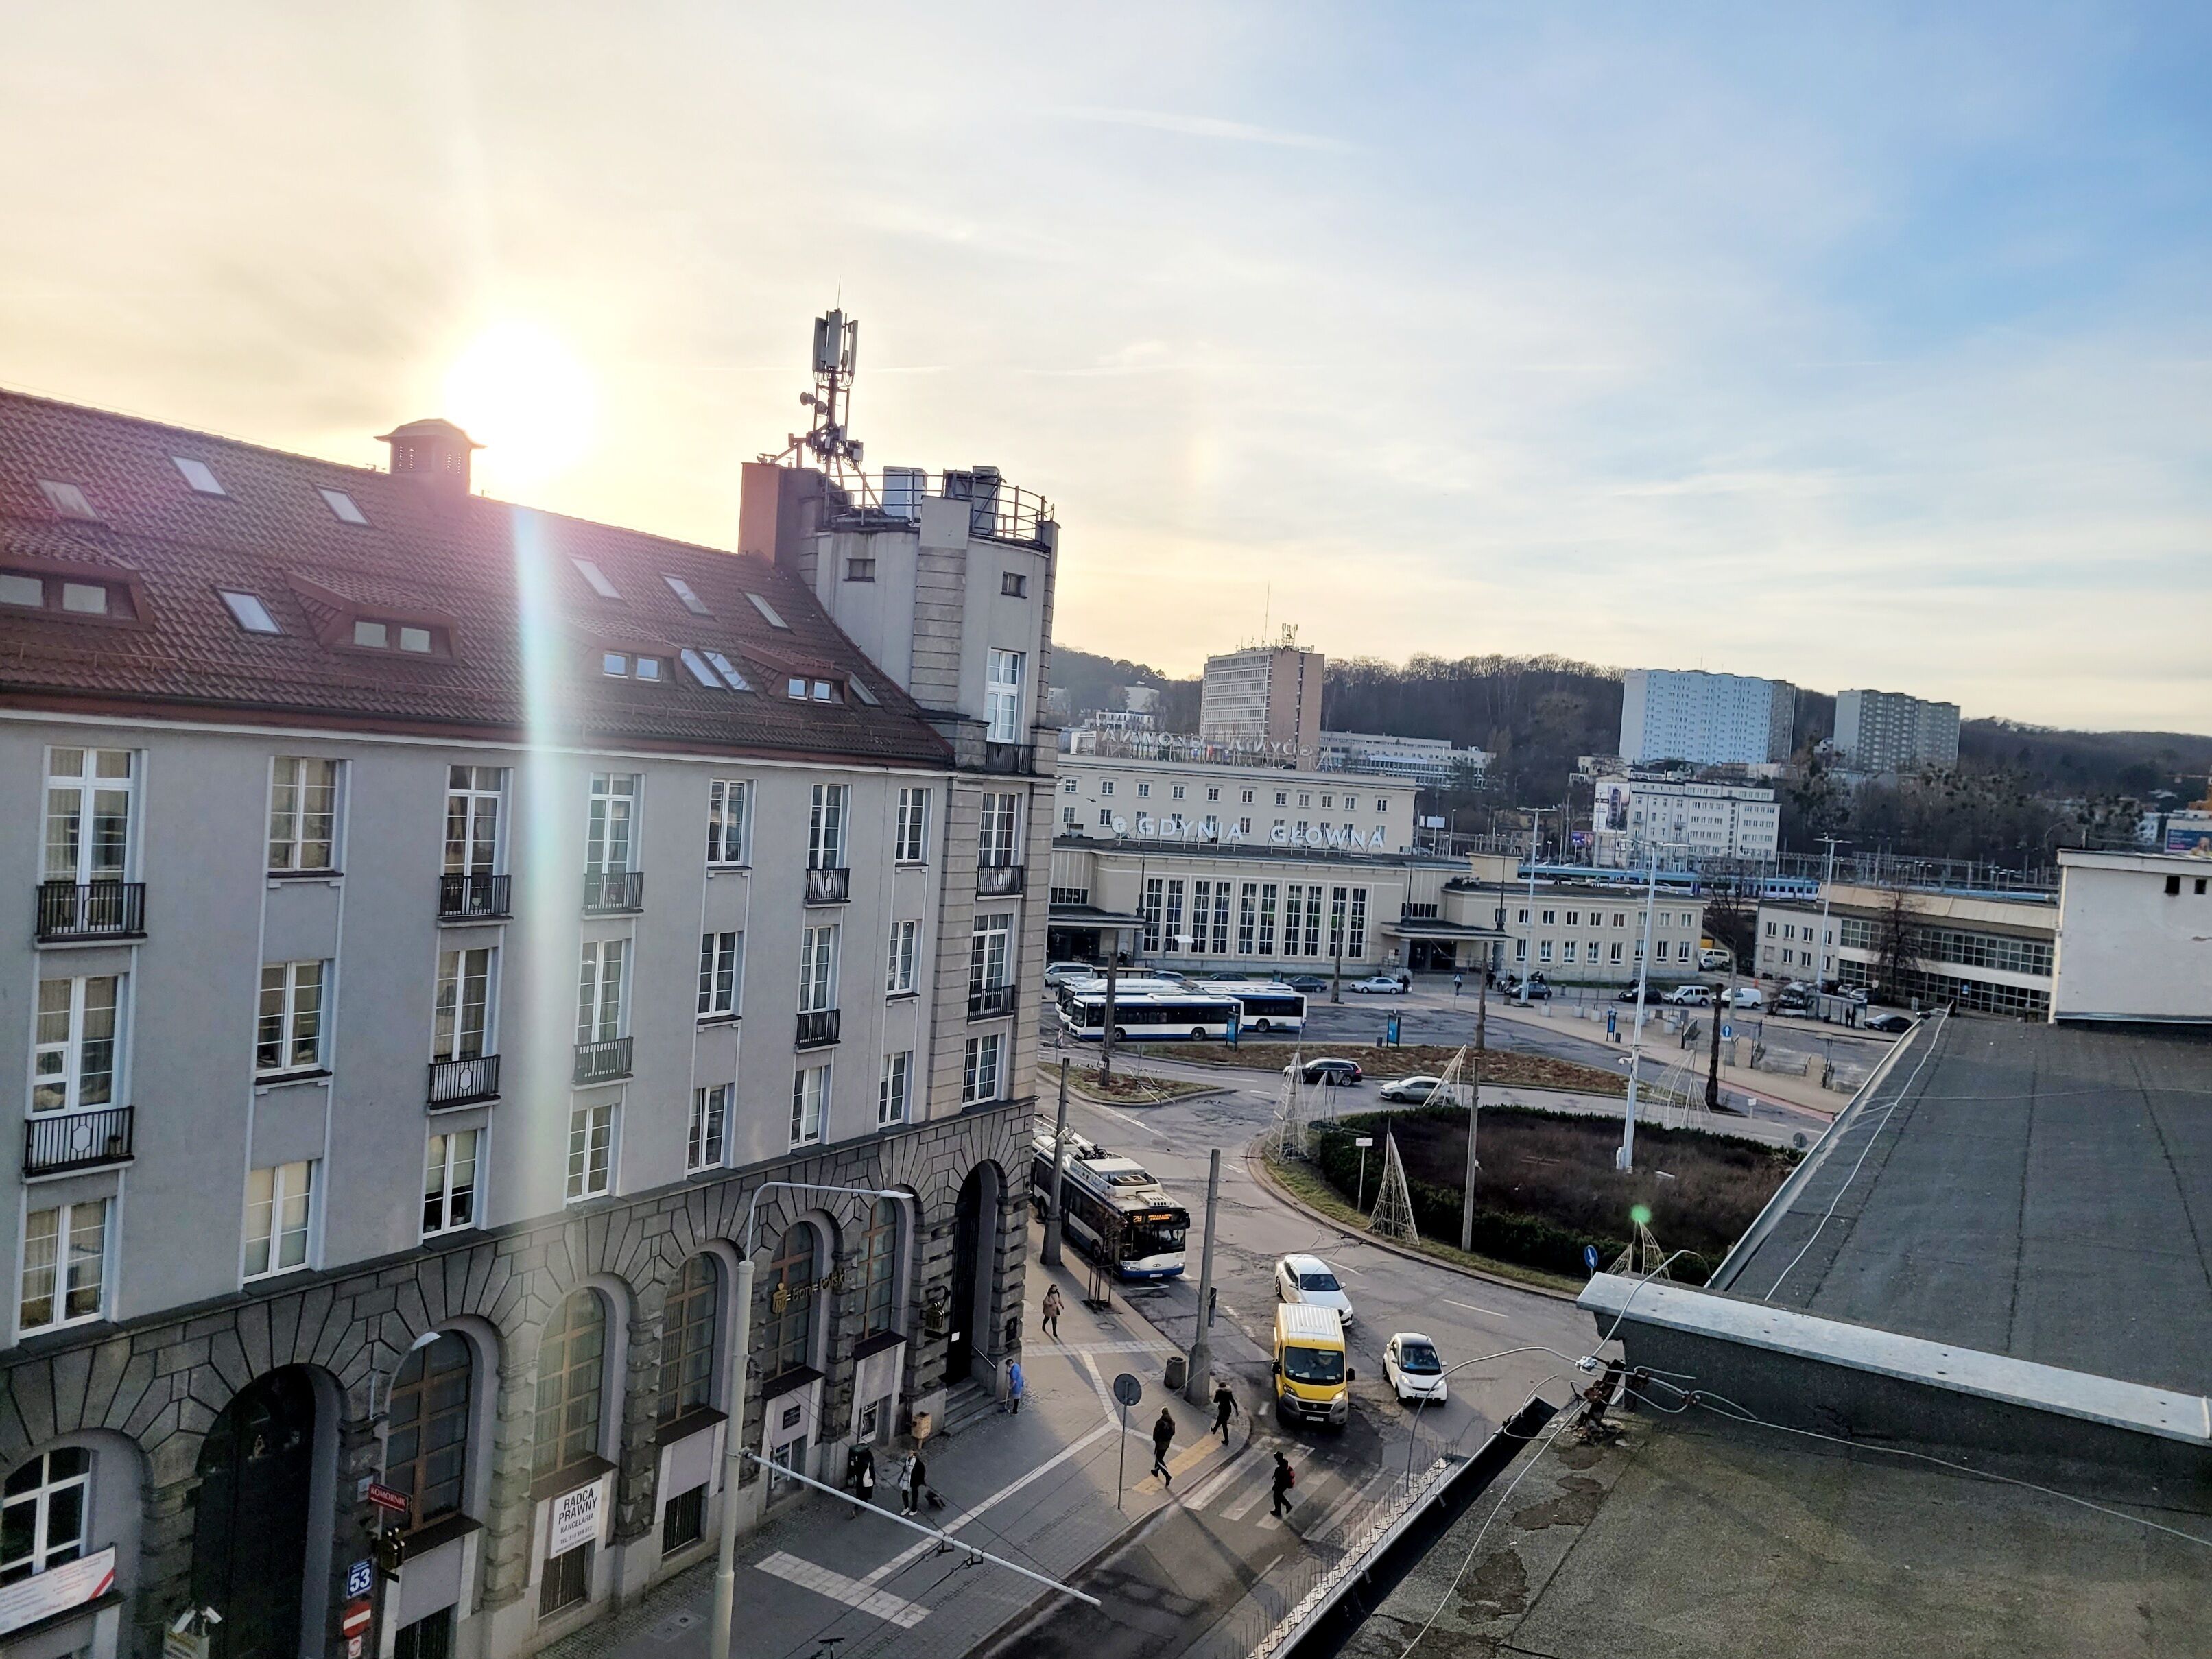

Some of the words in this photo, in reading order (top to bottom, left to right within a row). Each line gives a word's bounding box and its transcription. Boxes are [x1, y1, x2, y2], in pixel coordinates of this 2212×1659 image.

[1138, 817, 1244, 841] GDYNIA
[370, 1486, 405, 1507] KOMORNIK
[564, 1488, 594, 1510] RADCA
[558, 1496, 597, 1525] PRAWNY
[560, 1512, 594, 1534] KANCELARIA
[350, 1568, 370, 1592] 53
